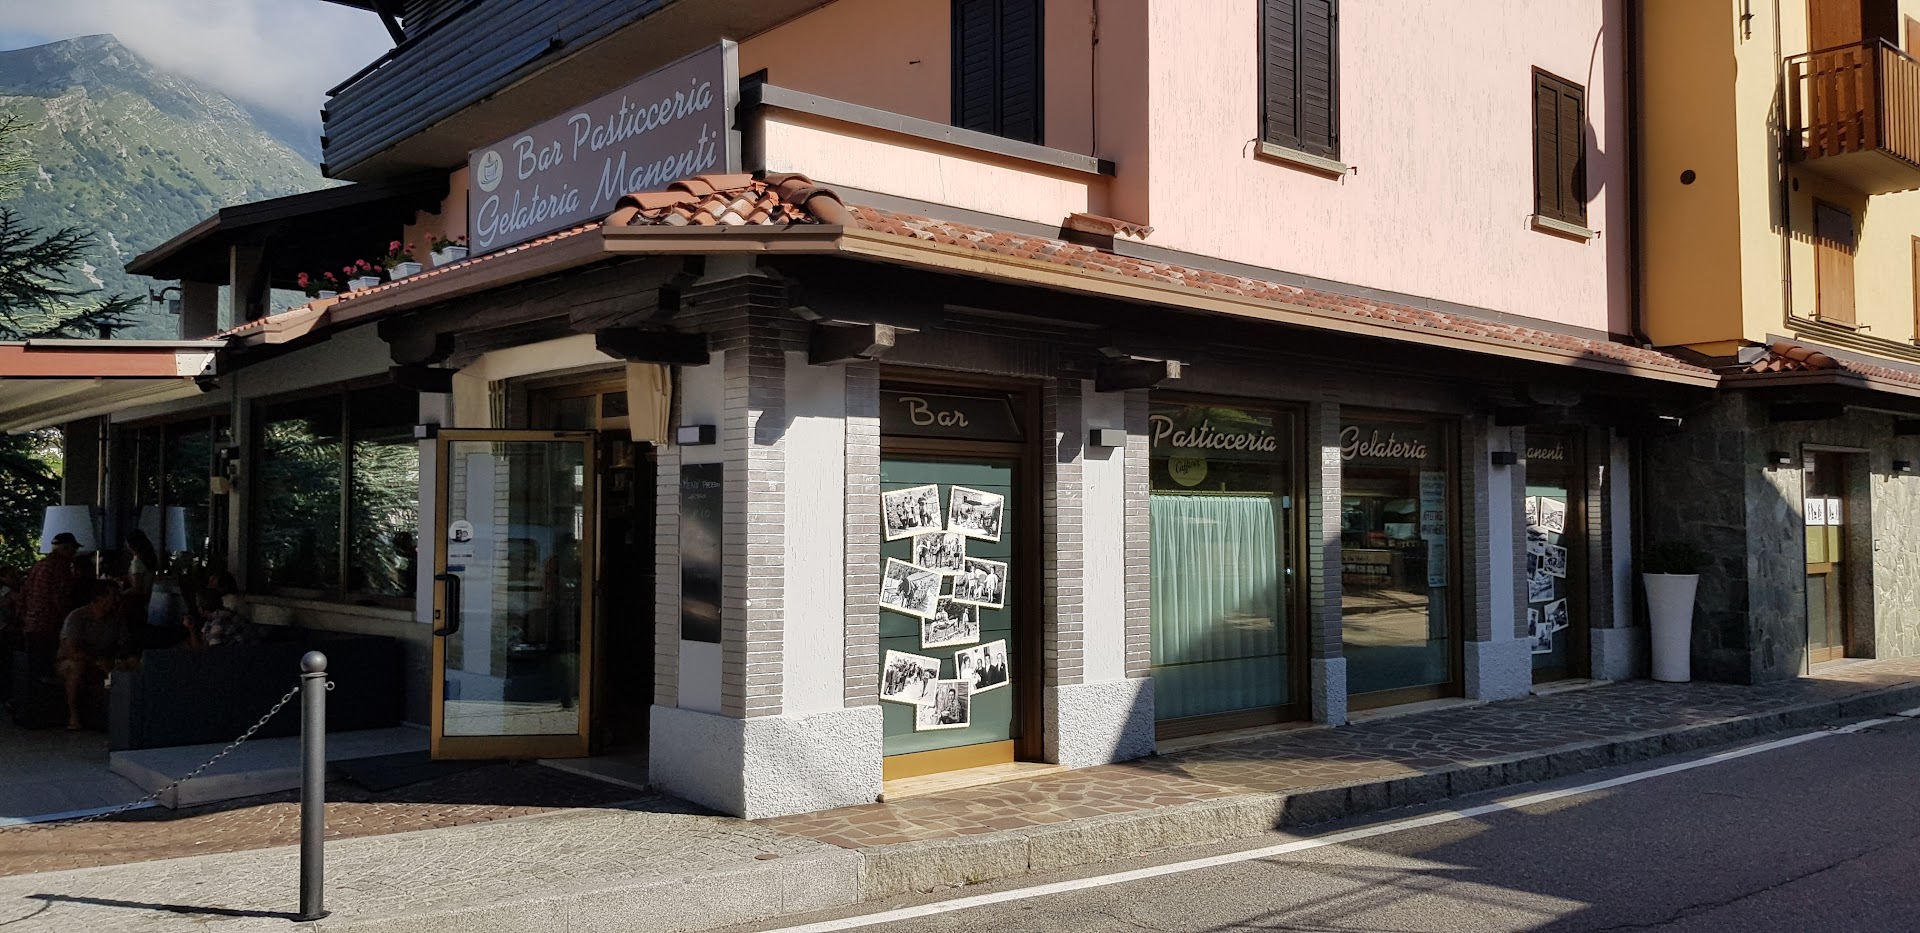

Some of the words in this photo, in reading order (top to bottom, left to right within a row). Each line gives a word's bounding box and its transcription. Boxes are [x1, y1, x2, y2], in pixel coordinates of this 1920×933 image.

[512, 135, 563, 181] Bar
[567, 77, 714, 161] Pasticceria
[476, 183, 580, 248] Gelateria
[589, 123, 718, 213] Manenti
[898, 396, 968, 427] Bar
[1149, 414, 1277, 452] Pasticceria
[1340, 425, 1427, 460] Gelateria
